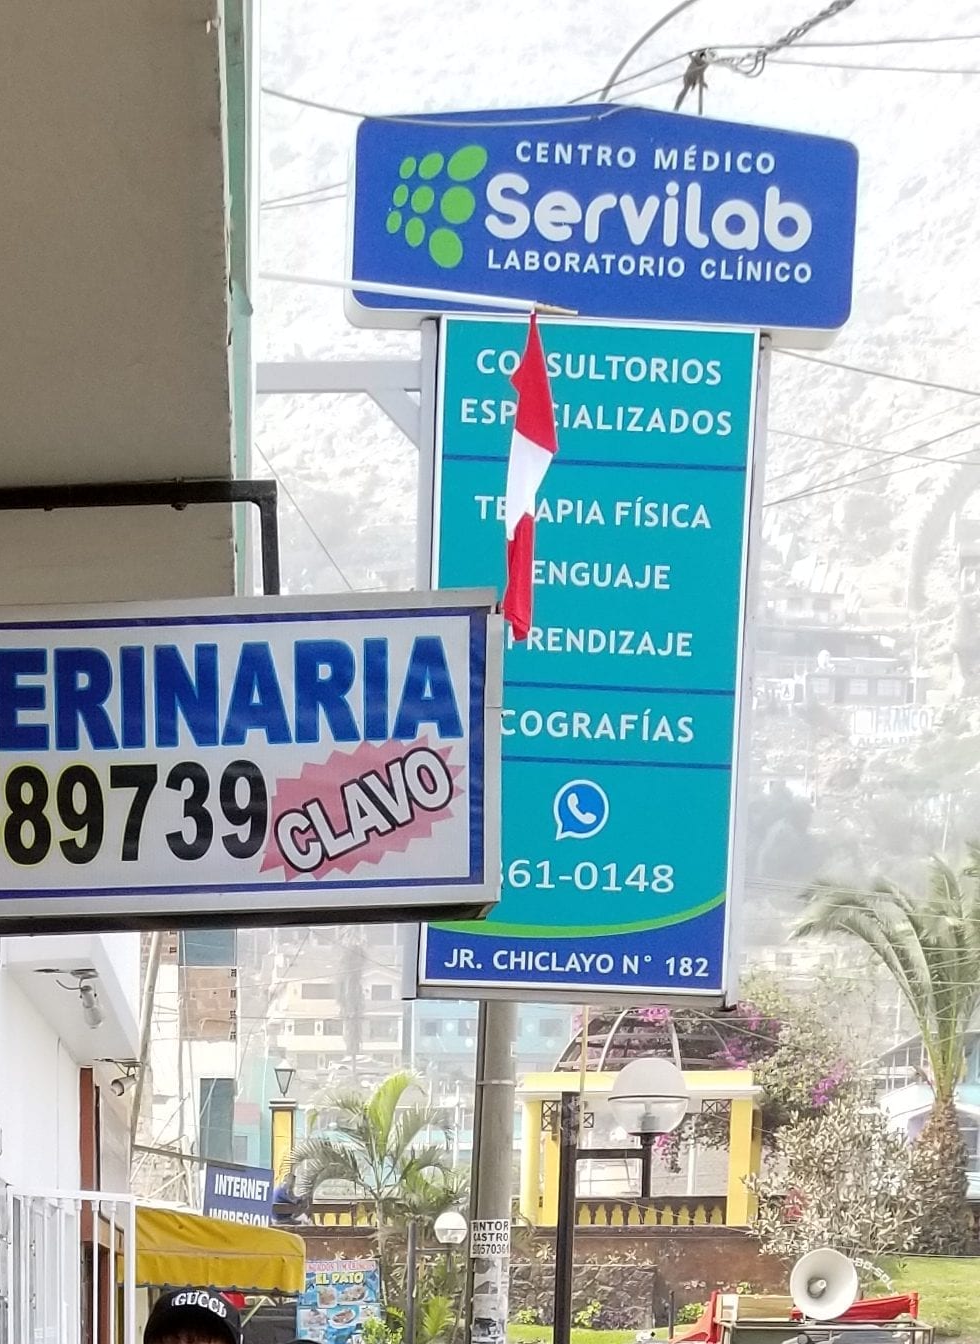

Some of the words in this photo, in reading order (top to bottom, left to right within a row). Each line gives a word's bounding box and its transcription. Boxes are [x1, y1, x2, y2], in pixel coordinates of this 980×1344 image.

[516, 141, 636, 168] CENTRO
[654, 145, 776, 174] MÉDICO
[485, 173, 812, 252] Servilab
[488, 249, 686, 278] LABORATORIO
[700, 254, 812, 283] CLÍNICO
[476, 348, 722, 385] COSULTORIOS
[461, 398, 733, 436] ESPIALIZADOS
[474, 495, 605, 525] TEAPIA
[615, 495, 711, 529] FÍSICA
[532, 559, 672, 591] ENGUAJE
[501, 708, 694, 744] COGRAFÍAS
[274, 747, 453, 872] CLAVO
[501, 858, 675, 894] 61-0148
[444, 948, 483, 969] JR.
[492, 950, 614, 974] CHICLAYO
[622, 954, 652, 975] N°
[665, 957, 709, 977] 182
[214, 1173, 270, 1202] INTERNET
[316, 1273, 330, 1284] EL
[332, 1272, 364, 1284] PATO
